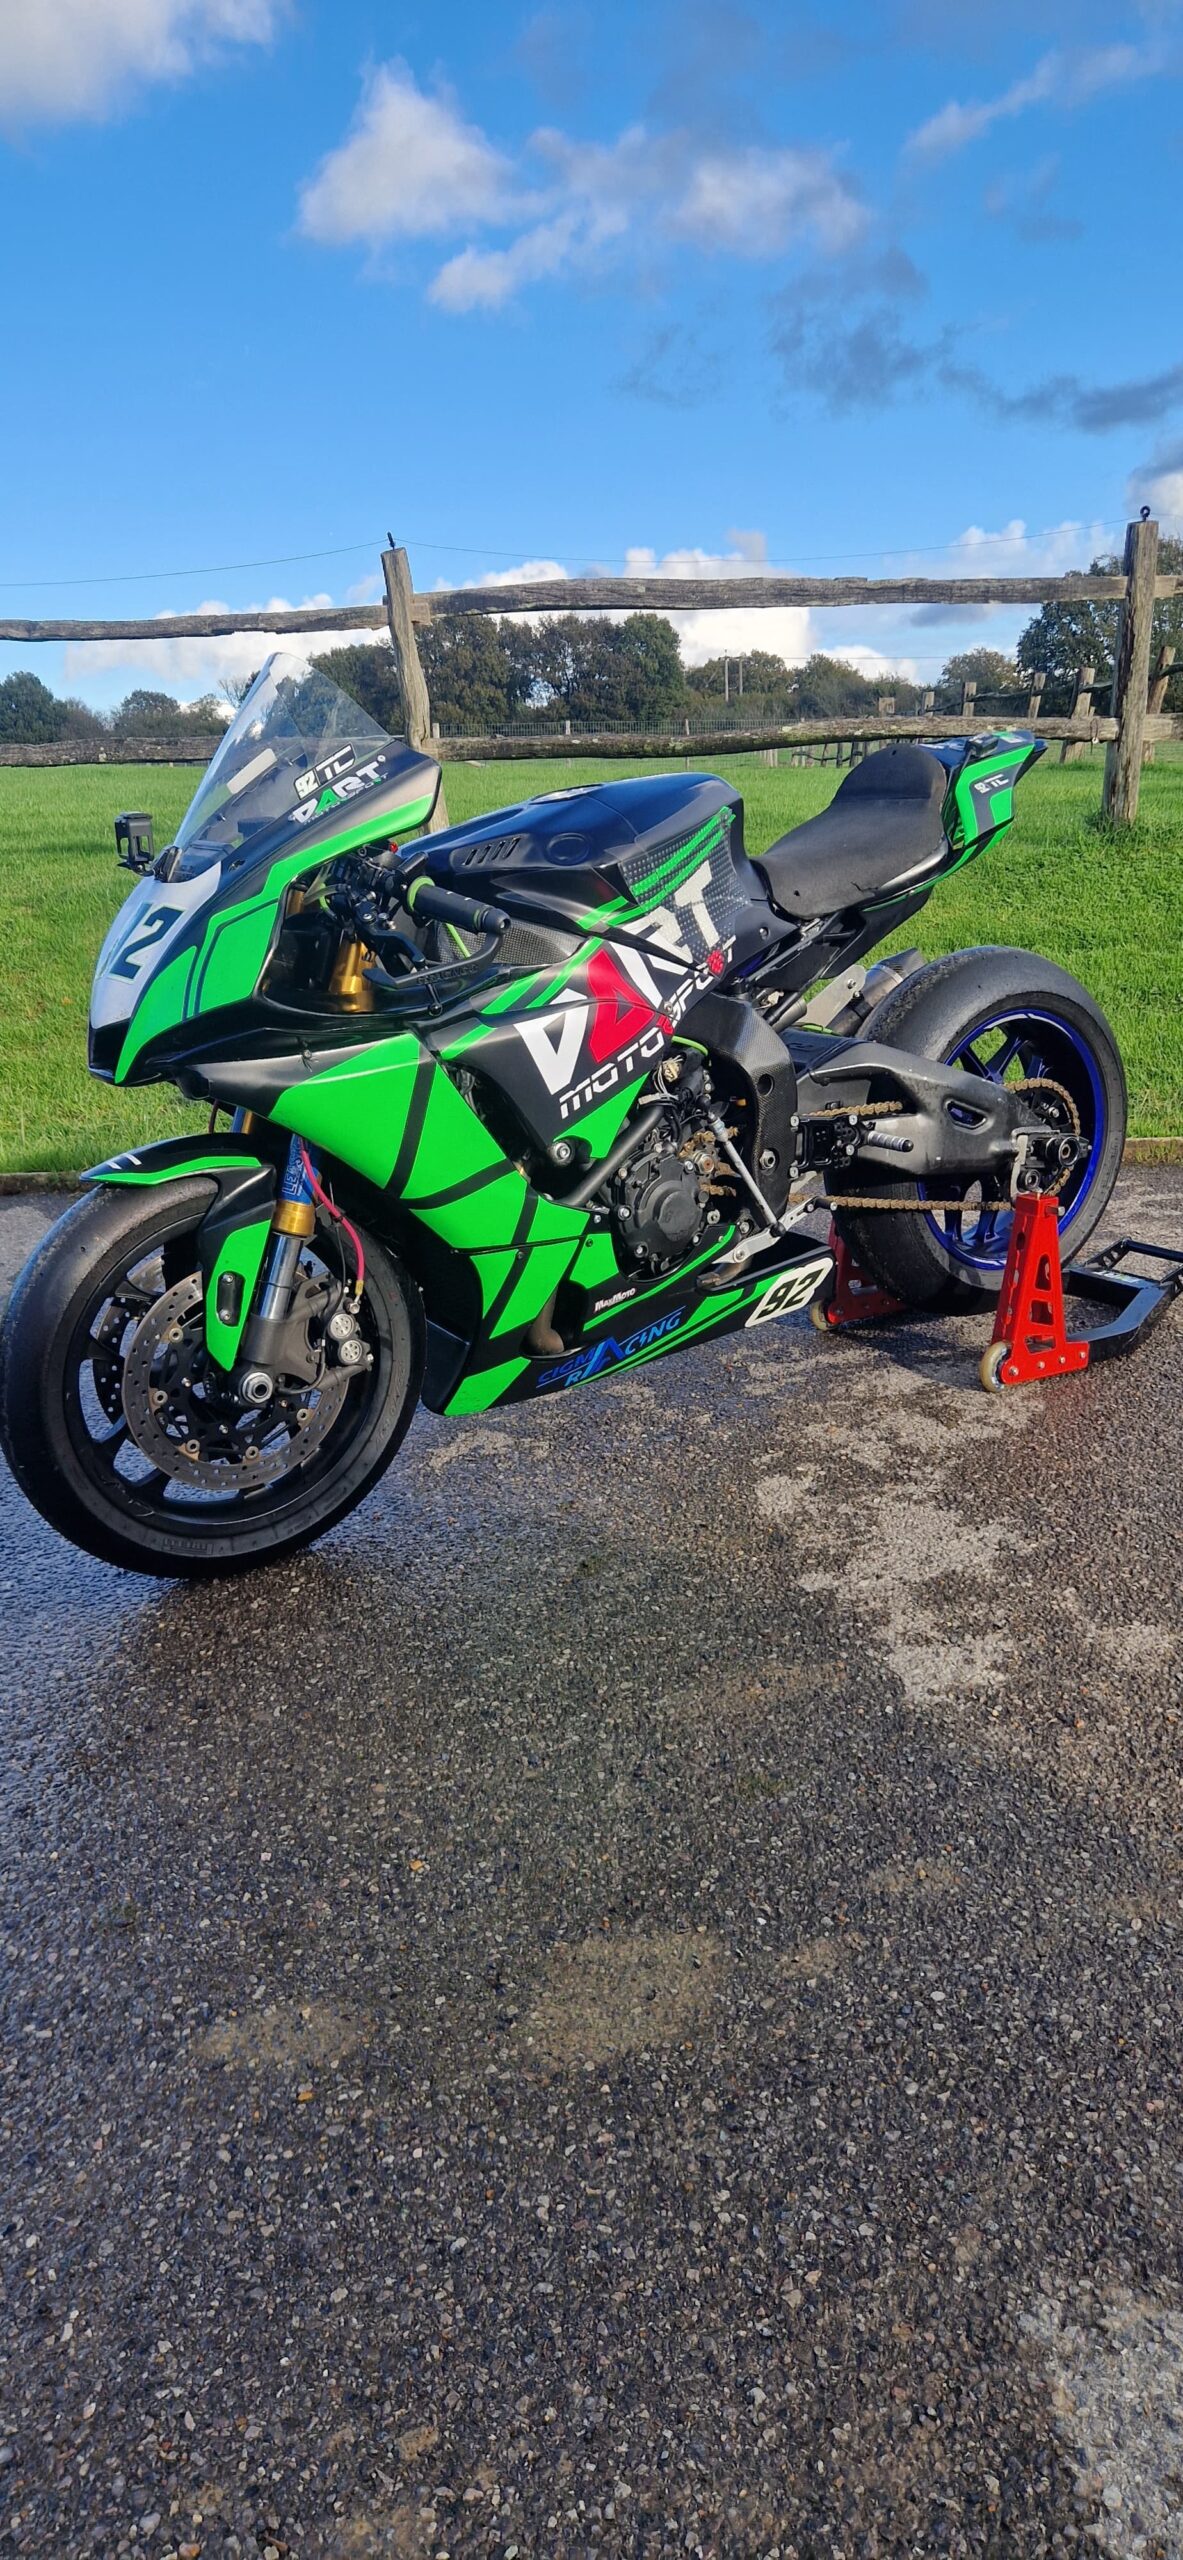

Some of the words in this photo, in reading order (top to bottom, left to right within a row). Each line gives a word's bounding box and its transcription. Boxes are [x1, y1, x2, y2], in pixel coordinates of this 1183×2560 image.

[296, 771, 318, 799] 92
[315, 745, 351, 780] TC
[514, 860, 720, 1095] DART
[755, 1268, 824, 1320] 92
